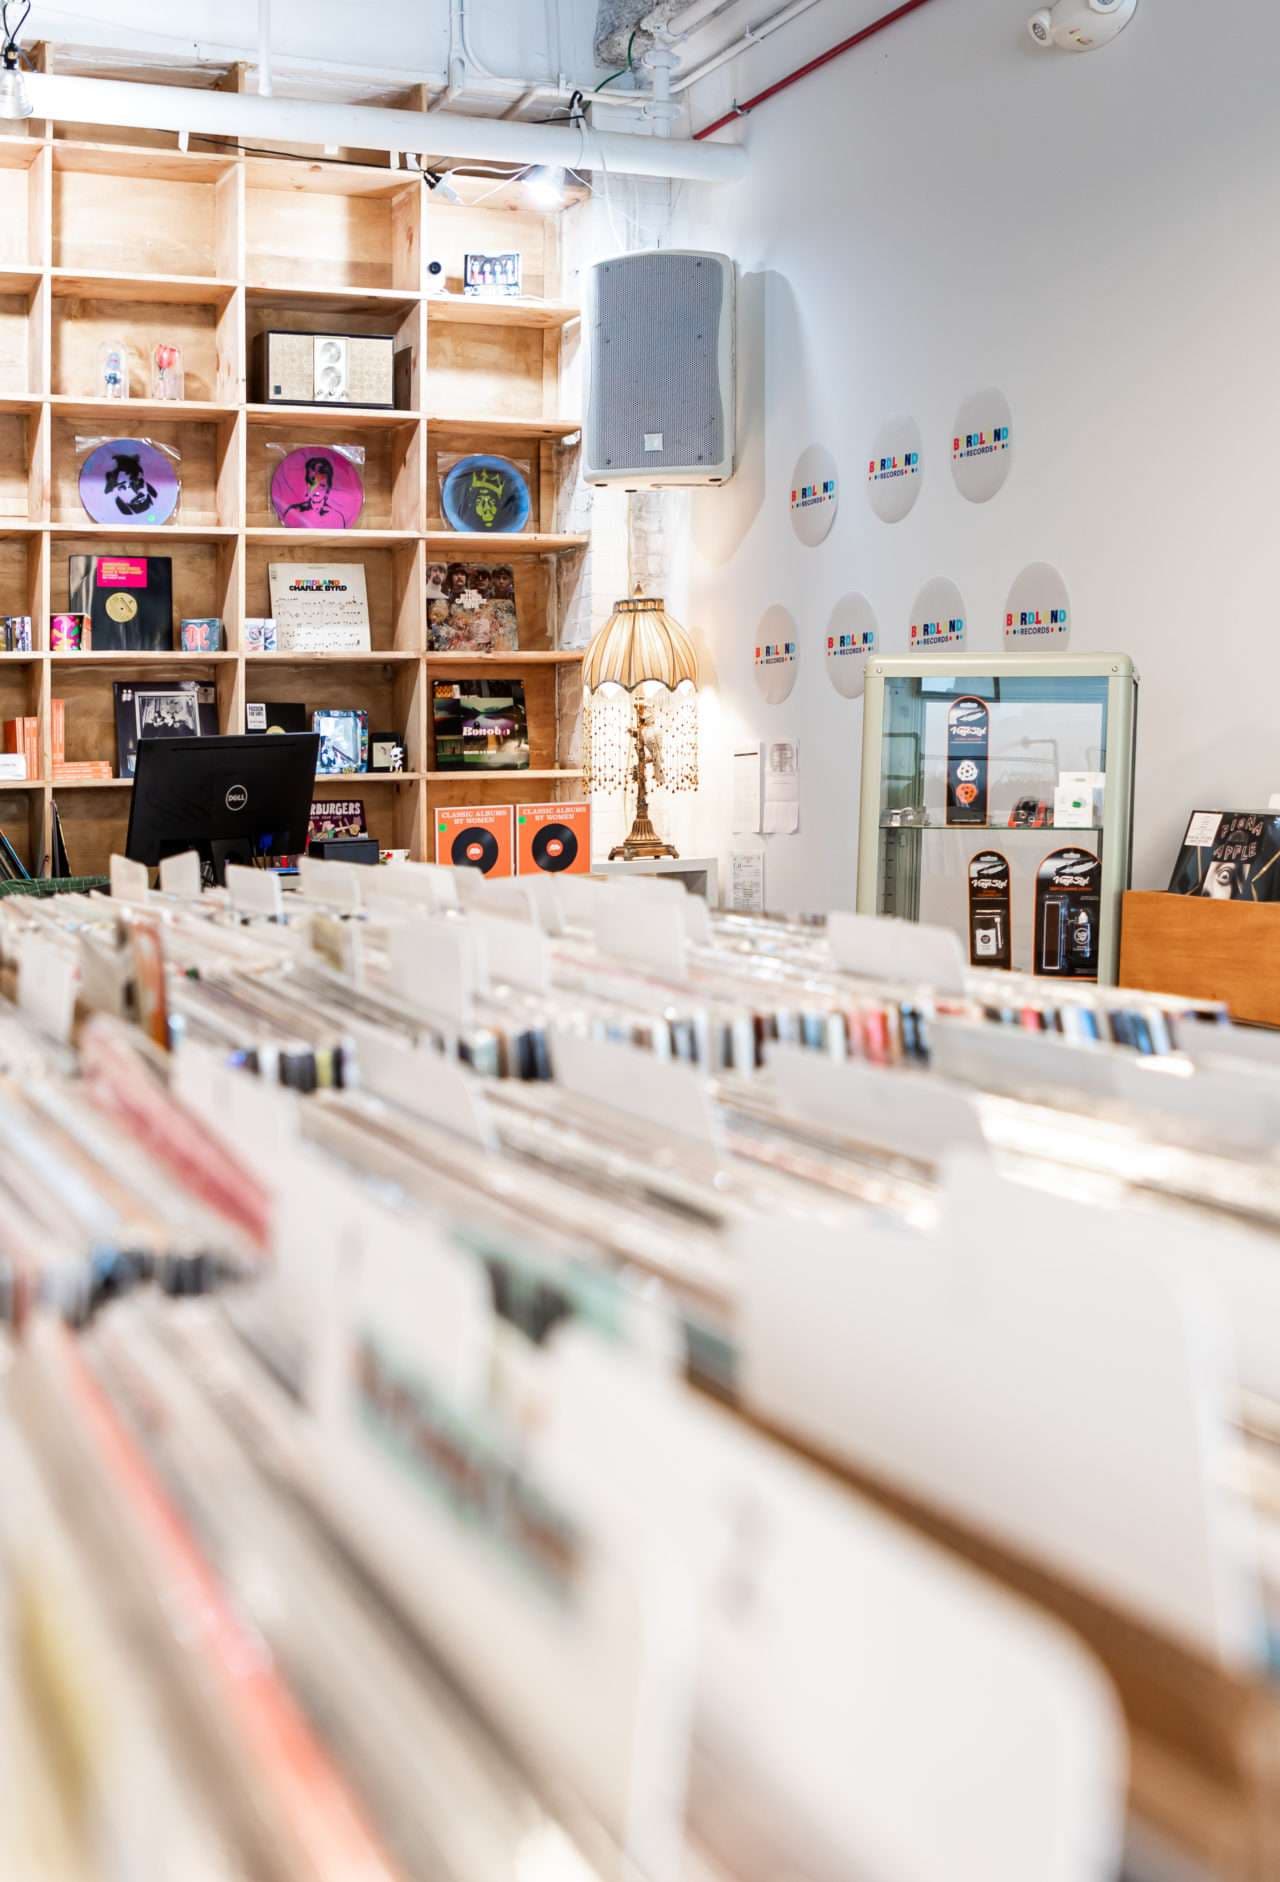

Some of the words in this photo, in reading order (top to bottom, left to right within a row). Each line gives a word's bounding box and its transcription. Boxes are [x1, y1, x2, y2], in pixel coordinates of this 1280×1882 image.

[462, 725, 511, 736] Bonobo
[228, 794, 245, 802] DELL
[1213, 842, 1257, 861] APPLE
